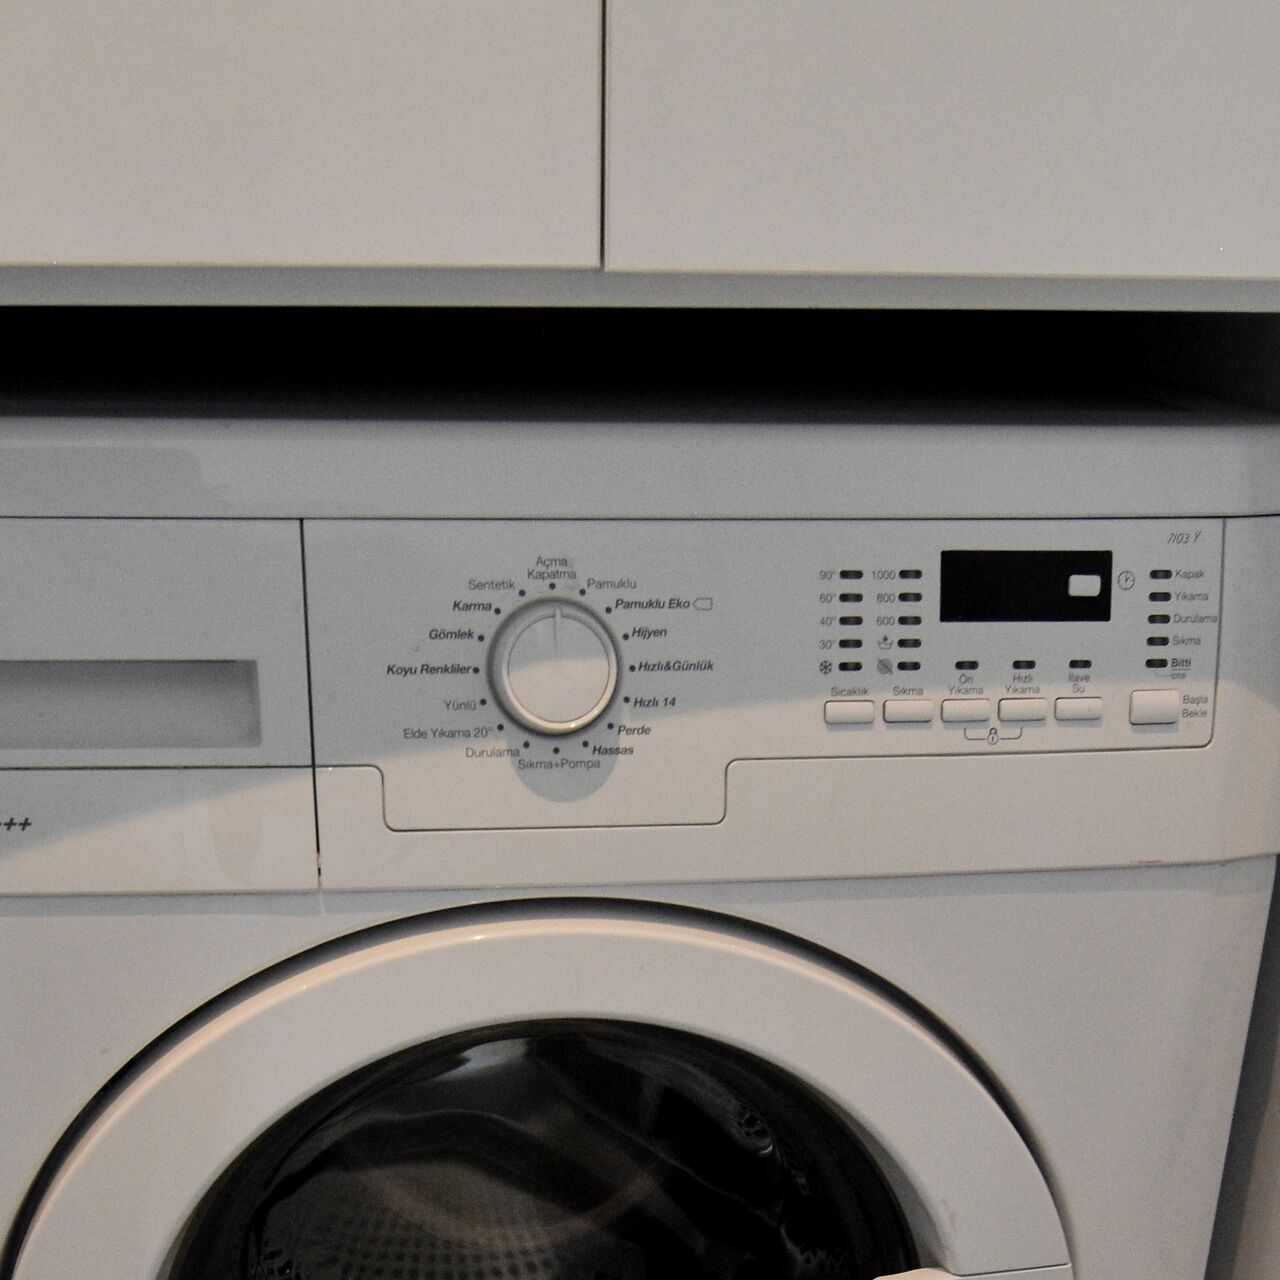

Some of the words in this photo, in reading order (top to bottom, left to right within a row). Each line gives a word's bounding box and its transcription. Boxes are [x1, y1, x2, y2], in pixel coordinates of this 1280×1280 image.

[536, 556, 568, 569] Açma
[527, 569, 577, 581] Kapatma
[872, 570, 896, 580] 1000
[468, 579, 516, 591] Sentetik
[587, 579, 637, 590] Pamuklu
[615, 599, 666, 610] Pamuklu
[667, 598, 691, 609] Eko
[876, 593, 896, 603] 800
[453, 601, 493, 611] Karma
[876, 616, 895, 626] 600
[429, 629, 475, 640] Gömlek
[632, 627, 668, 640] Hijyen
[638, 660, 714, 672] Hızlı&Günlük
[1171, 657, 1192, 668] Bitti
[387, 664, 417, 677] Koyu
[420, 663, 472, 674] Renkliler
[444, 699, 477, 711] Yünlü
[633, 697, 658, 708] Hızlı
[662, 696, 676, 707] 14
[403, 728, 428, 739] Elde
[431, 728, 471, 738] Yıkama
[617, 725, 651, 736] Perde
[466, 746, 520, 758] Durulama
[592, 744, 635, 755] Hassas
[518, 758, 601, 771] Sıkma+Pompa
